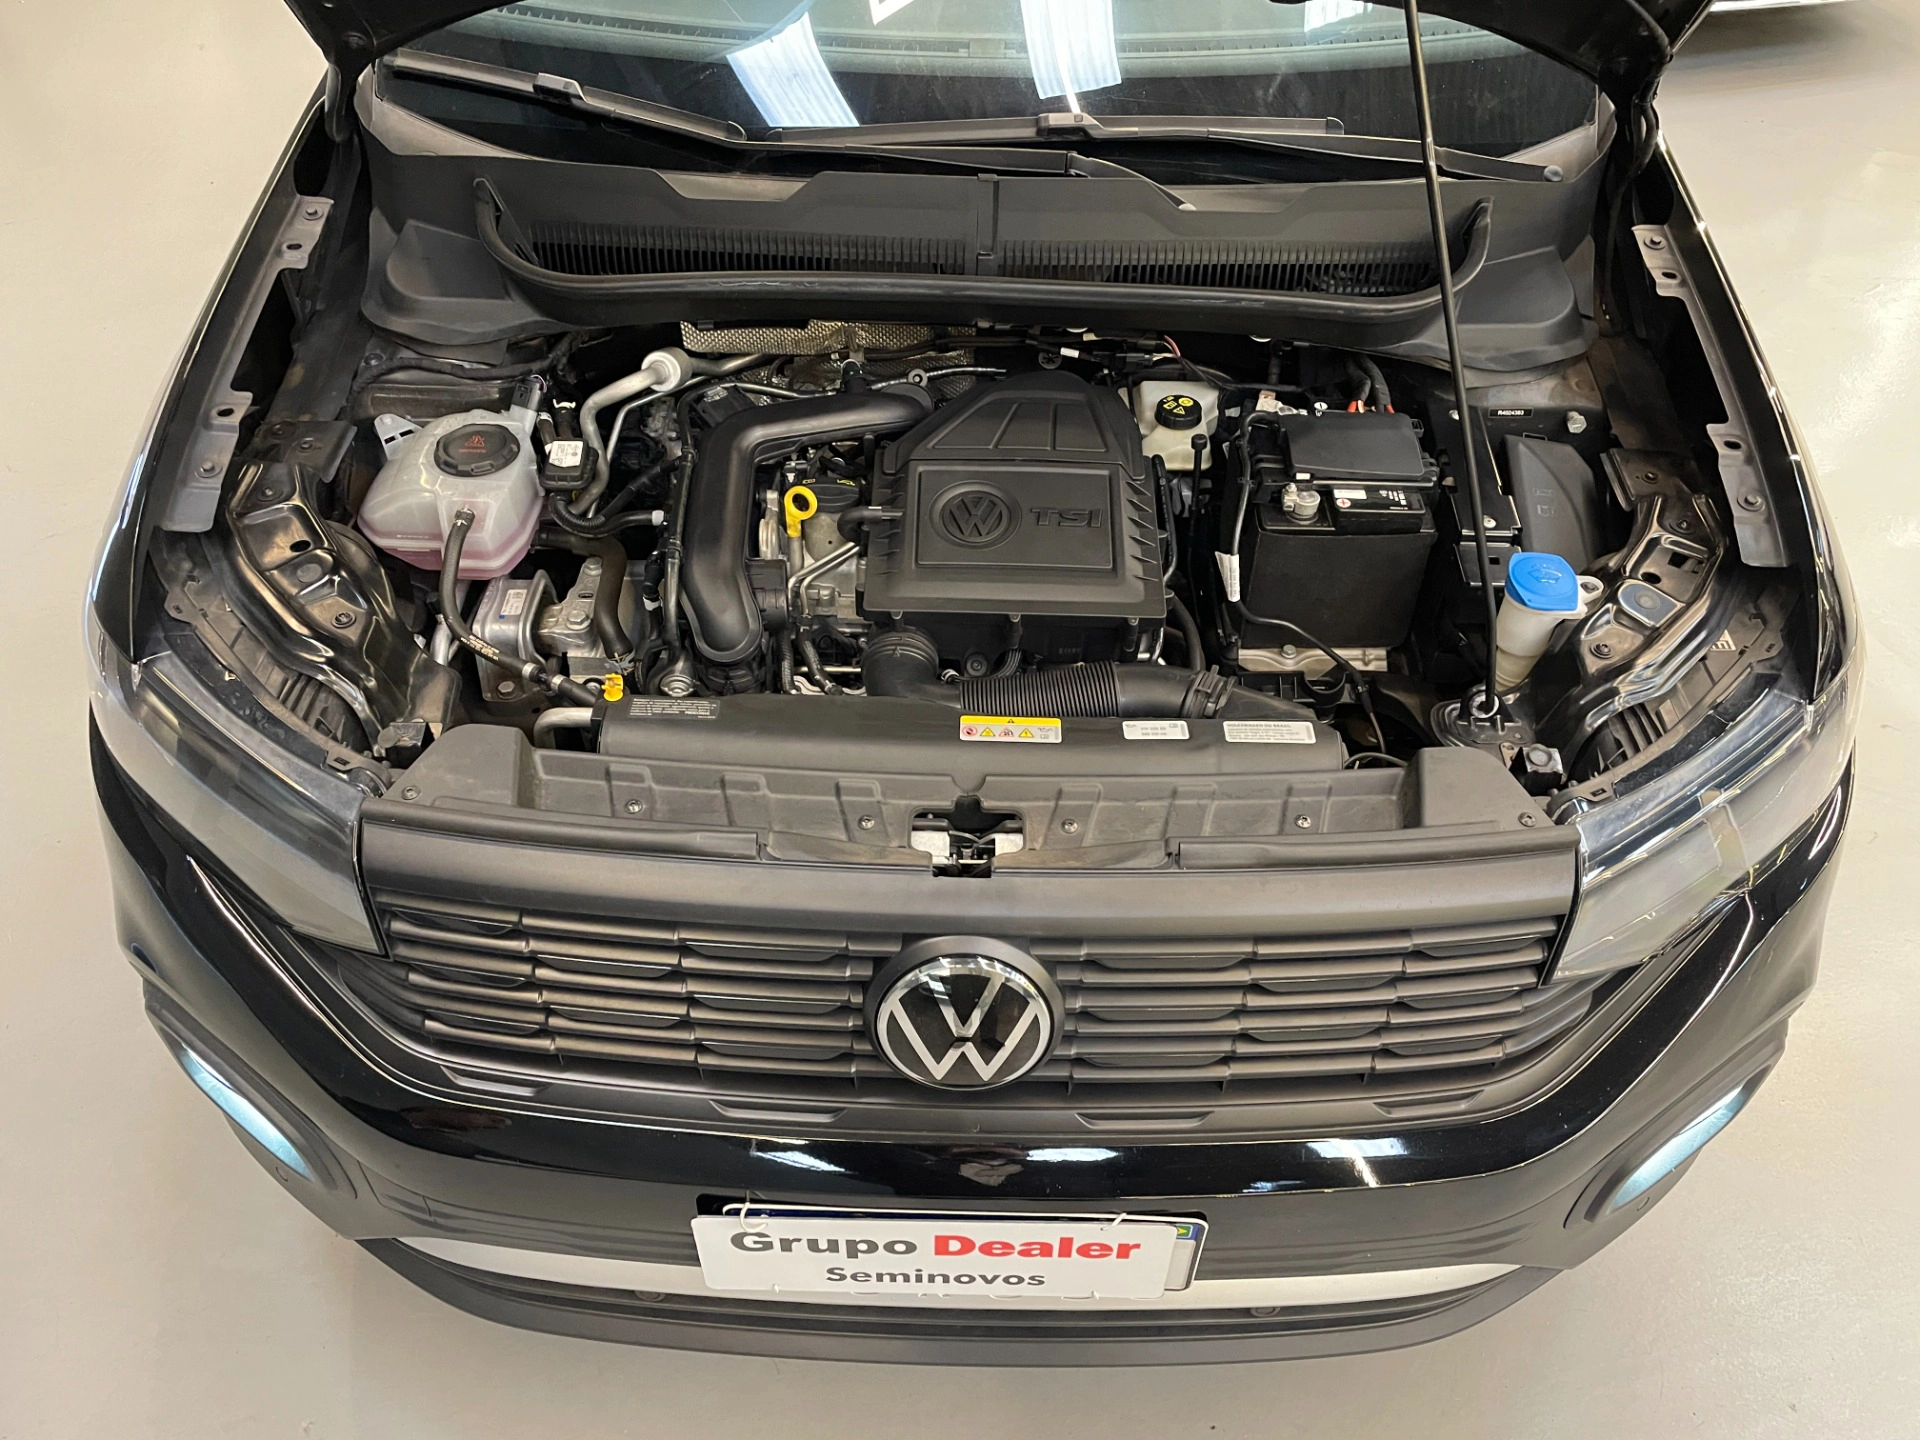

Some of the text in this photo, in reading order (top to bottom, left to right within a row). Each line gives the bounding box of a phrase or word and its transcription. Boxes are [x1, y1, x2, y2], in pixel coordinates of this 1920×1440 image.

[944, 492, 1005, 541] VW
[1030, 507, 1104, 528] TSI
[880, 957, 1048, 1086] VW
[730, 1231, 1141, 1260] Grupo Dealer
[826, 1267, 1046, 1286] Seminovos
